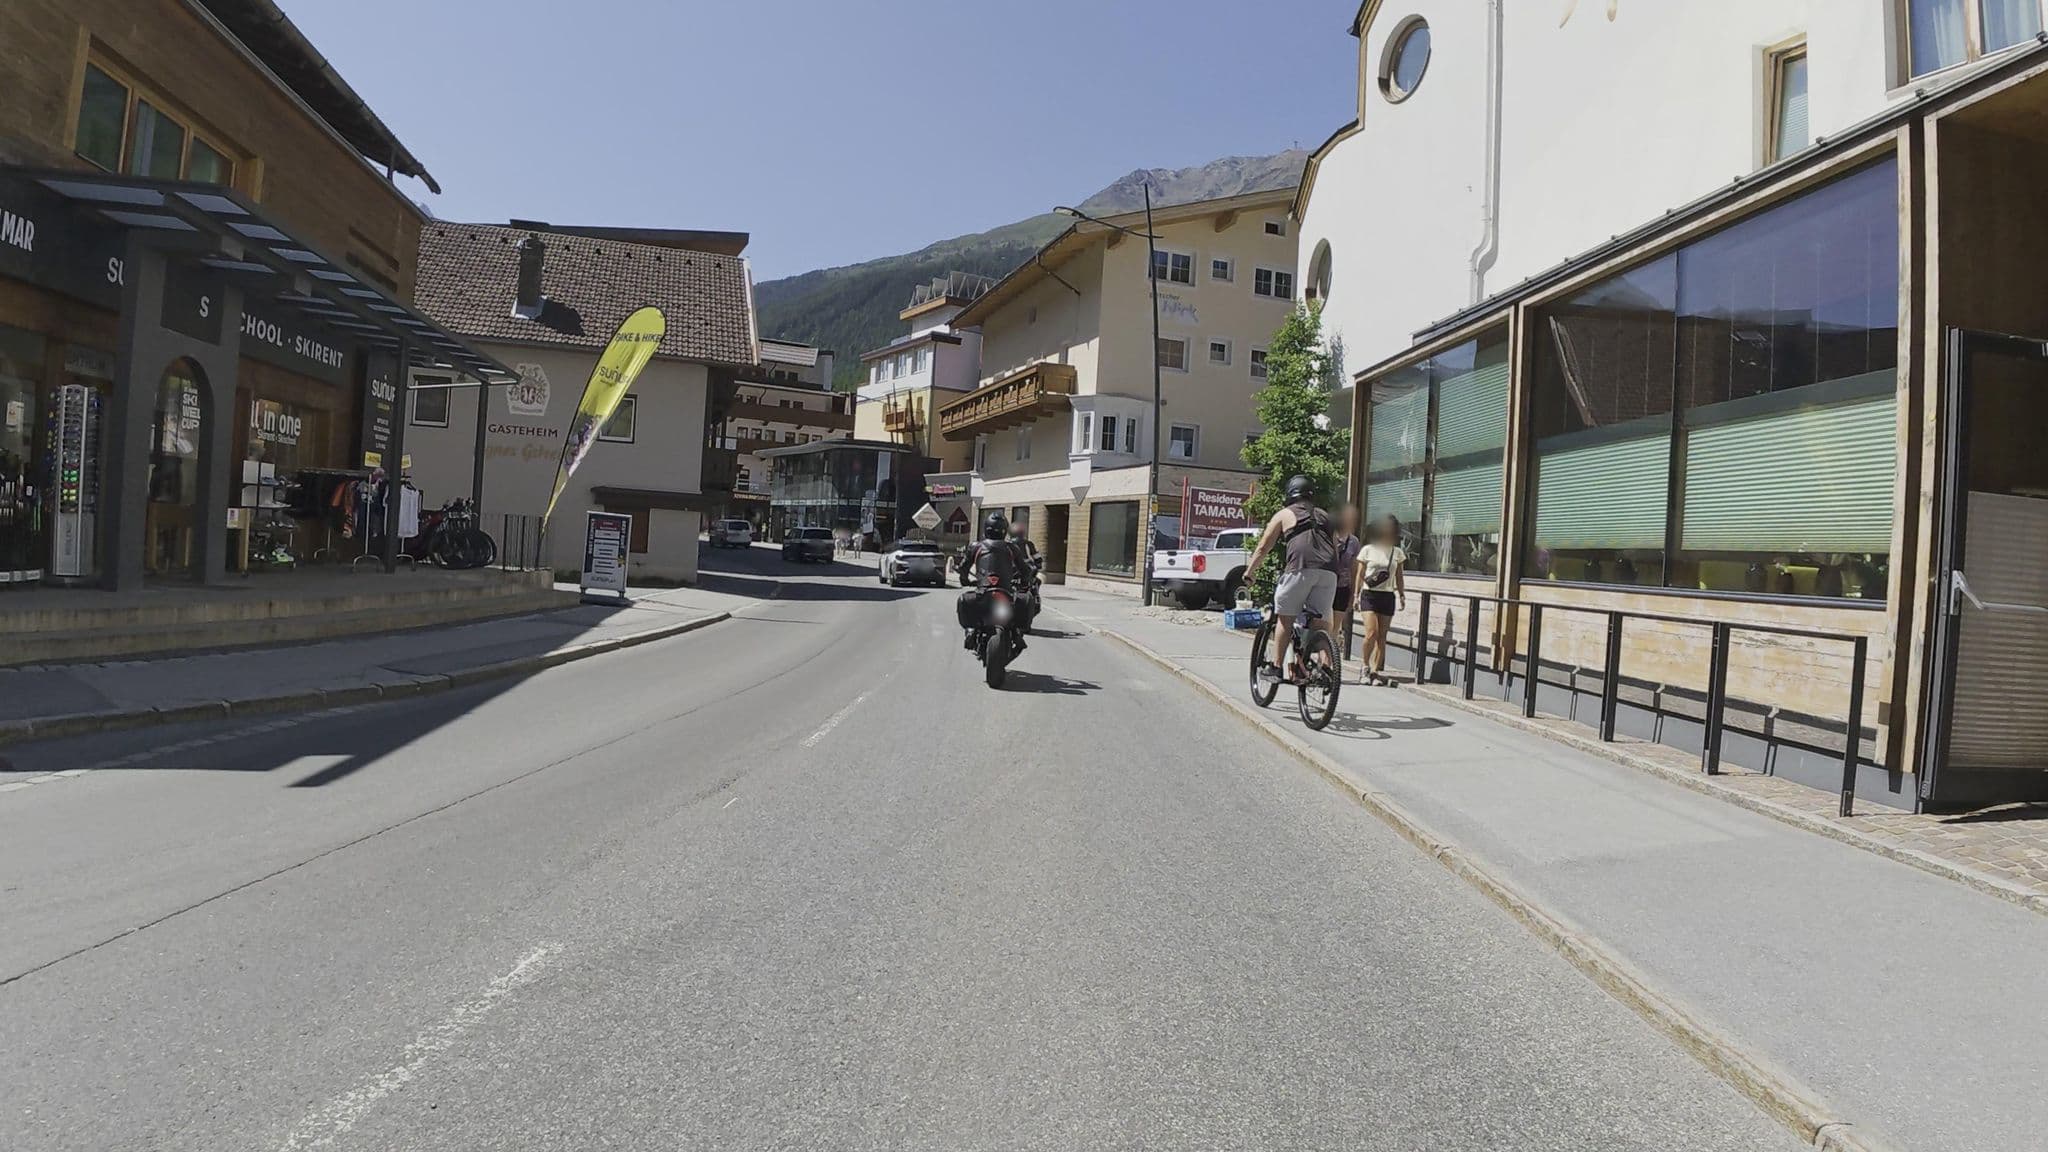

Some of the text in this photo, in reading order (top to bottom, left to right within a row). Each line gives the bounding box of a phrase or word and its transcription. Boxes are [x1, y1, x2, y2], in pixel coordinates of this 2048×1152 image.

[0, 208, 35, 251] MAR
[295, 335, 343, 368] SKIRENT
[263, 403, 276, 432] in
[279, 414, 301, 437] one
[1193, 504, 1246, 520] TAMARA
[1198, 491, 1242, 505] Residenz
